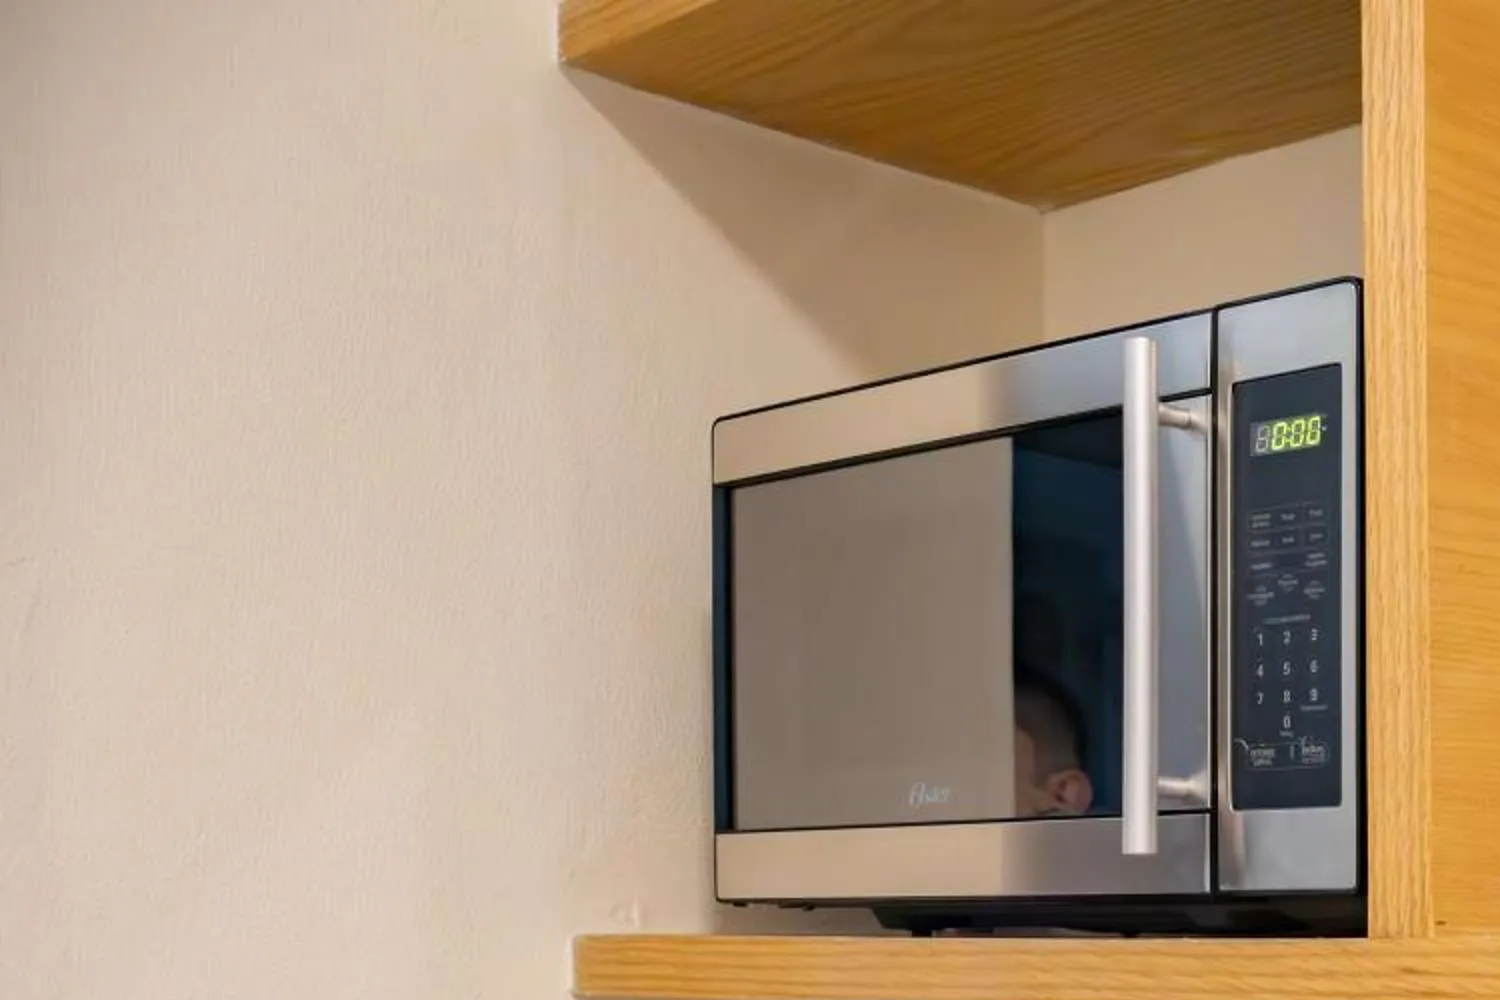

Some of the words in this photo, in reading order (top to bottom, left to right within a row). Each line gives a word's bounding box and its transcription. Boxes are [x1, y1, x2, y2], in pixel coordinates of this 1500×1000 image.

[1256, 632, 1264, 646] 1
[1283, 630, 1292, 645] 2
[1256, 663, 1265, 677] 4
[1282, 660, 1291, 676] 5
[1256, 691, 1264, 705] 7
[1282, 715, 1291, 729] 0
